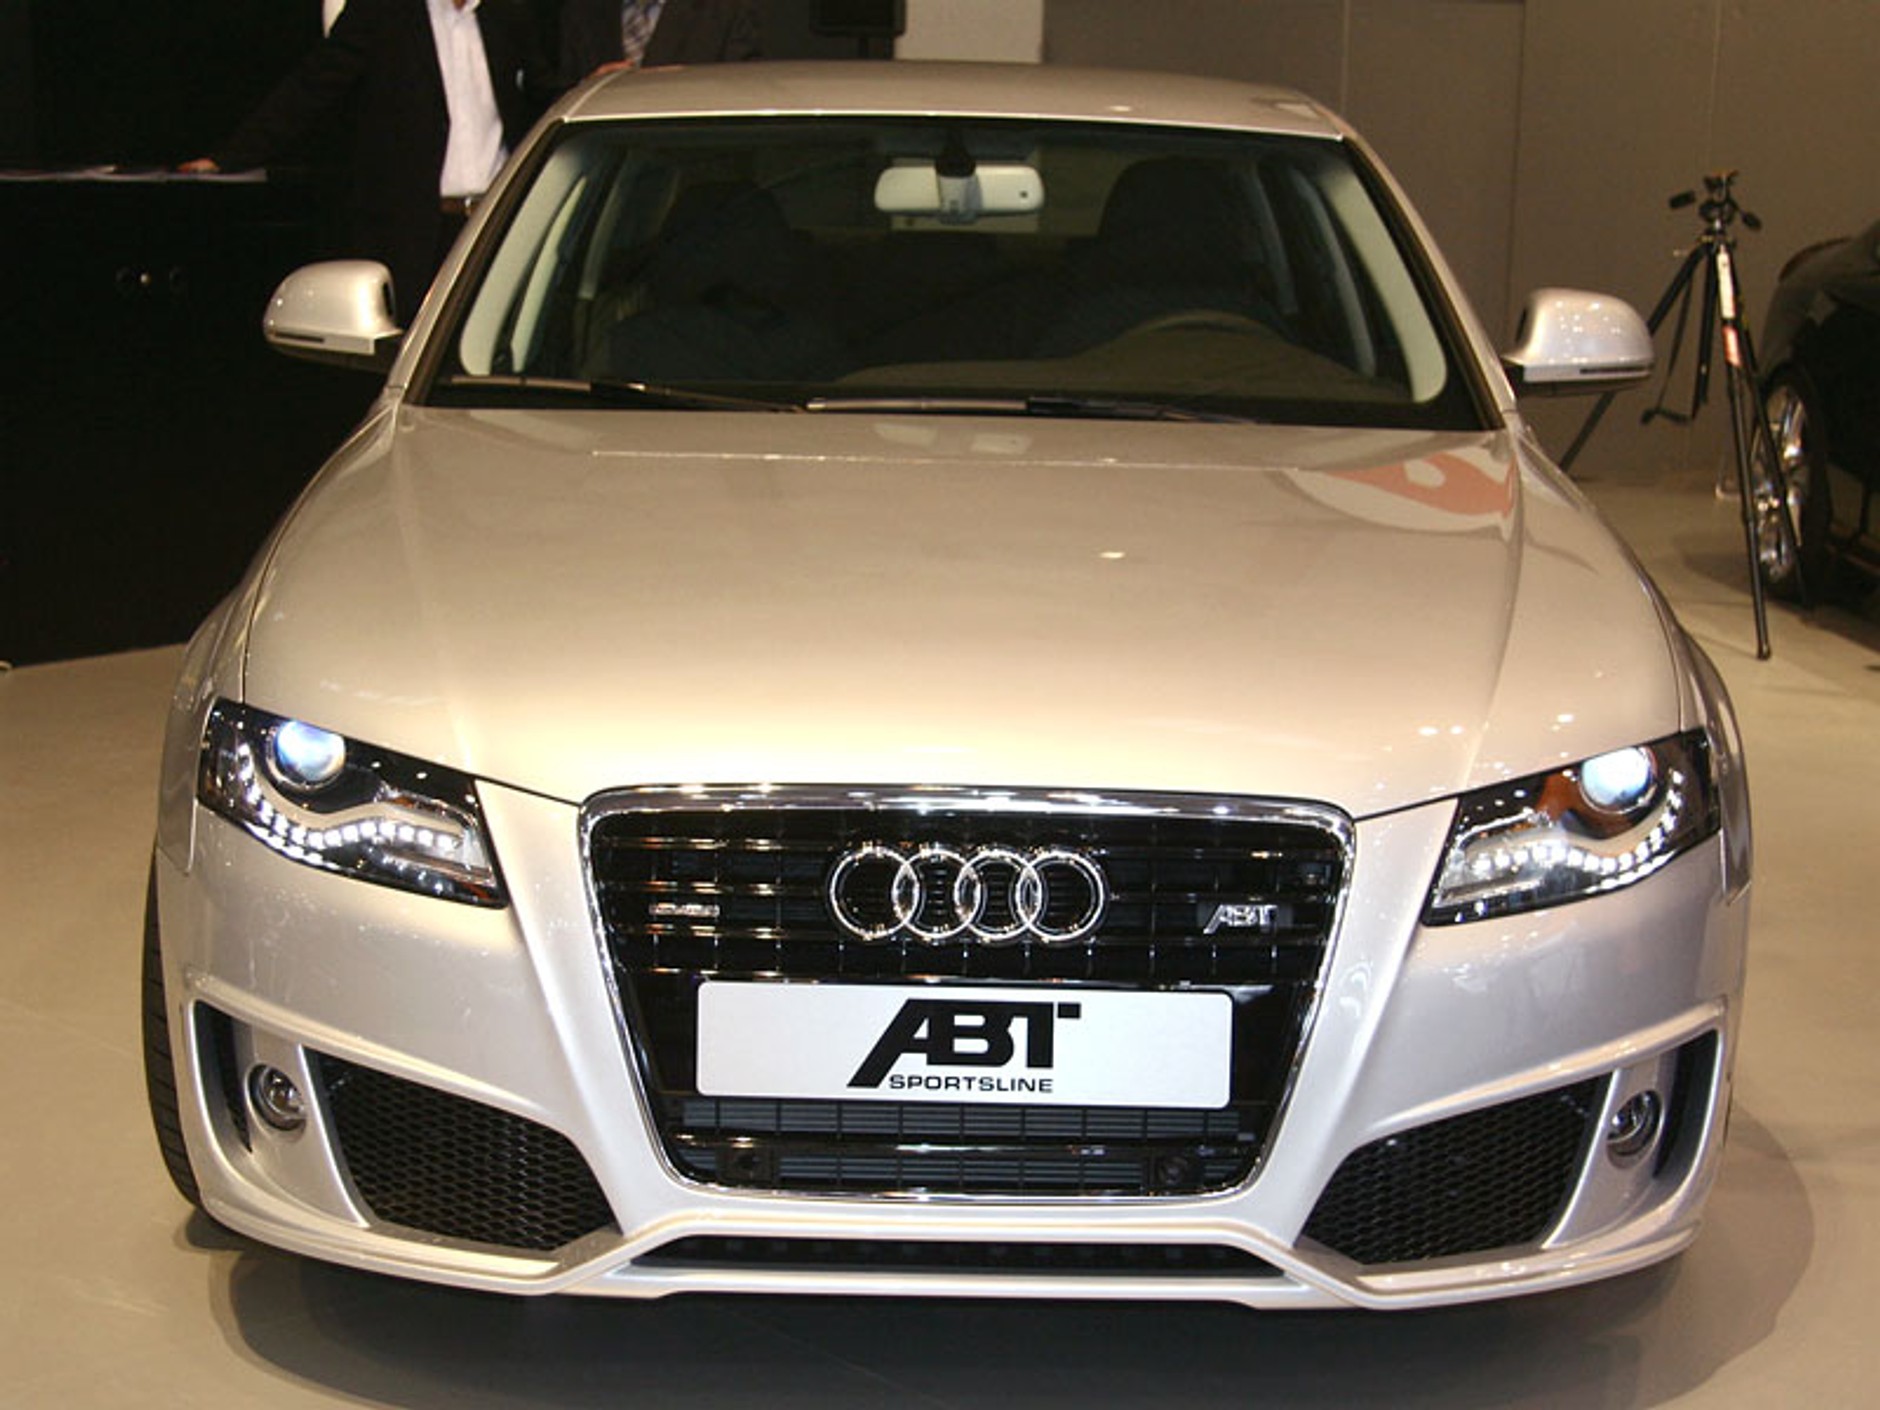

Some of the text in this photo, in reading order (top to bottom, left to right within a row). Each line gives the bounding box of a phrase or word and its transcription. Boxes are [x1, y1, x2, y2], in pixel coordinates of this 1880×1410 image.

[1203, 904, 1277, 934] ABT
[847, 998, 1081, 1088] ABT
[889, 1074, 1053, 1092] SPORTSLINE
